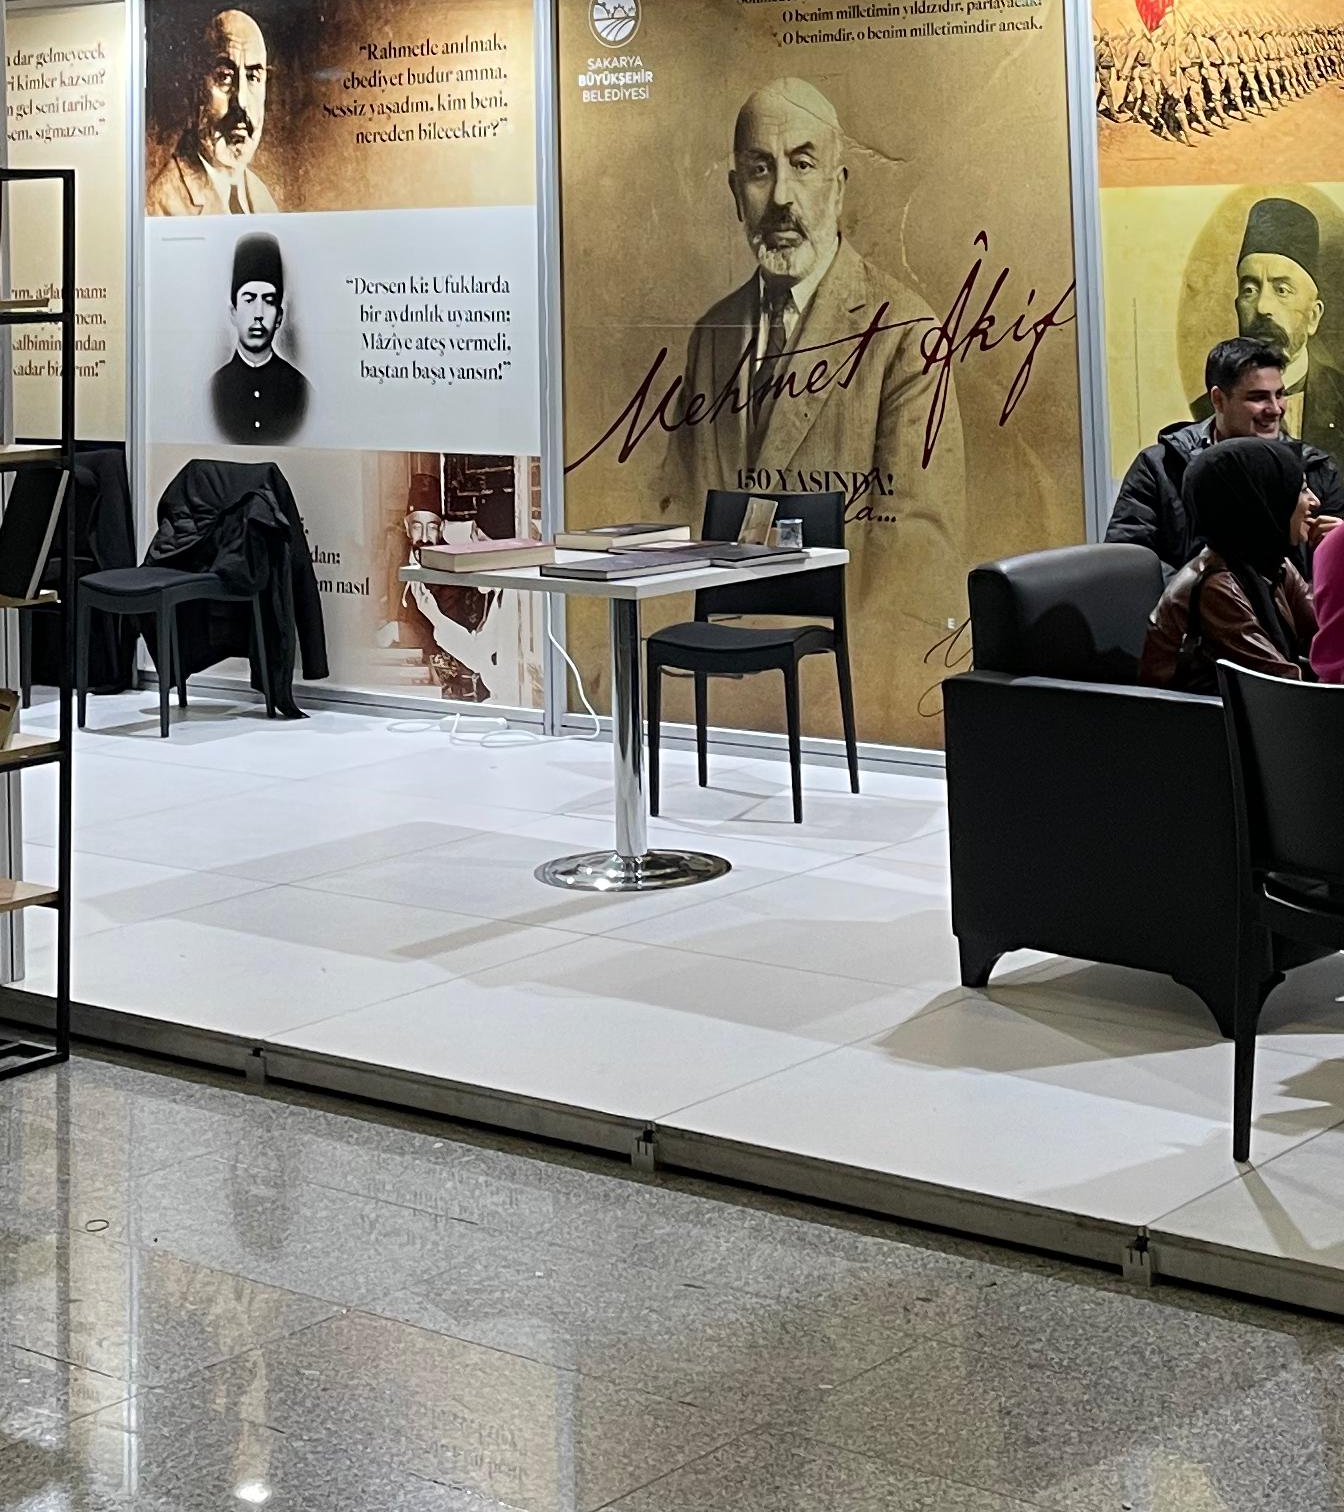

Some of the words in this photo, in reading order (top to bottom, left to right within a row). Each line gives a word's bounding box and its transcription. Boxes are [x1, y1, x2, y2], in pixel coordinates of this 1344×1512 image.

[782, 10, 793, 23] O
[795, 8, 834, 23] benim
[836, 3, 900, 20] milletimin
[783, 31, 793, 45] O
[857, 31, 865, 41] o
[868, 24, 907, 40] benim
[910, 19, 997, 37] milletimindir
[13, 49, 34, 66] dar
[587, 55, 643, 71] SAKARYA
[17, 73, 57, 91] kimler
[343, 69, 404, 93] ebediyet
[407, 65, 453, 86] budur
[578, 68, 654, 87] BÜYÜKŞEHİR
[582, 85, 650, 103] BELEDİYESİ
[16, 99, 33, 121] gel
[36, 97, 60, 114] seni
[322, 100, 367, 119] Sessiz
[437, 93, 467, 111] kim
[356, 124, 415, 144] nereden
[346, 277, 407, 295] “Dersen
[410, 275, 430, 294] ki:
[433, 275, 511, 295] Ufuklarda
[360, 304, 382, 323] bir
[384, 304, 444, 328] aydınlık
[415, 337, 446, 357] ateş
[360, 360, 409, 385] baştan
[412, 361, 446, 385] başa
[737, 467, 771, 491] 150
[336, 576, 370, 596] nasıl
